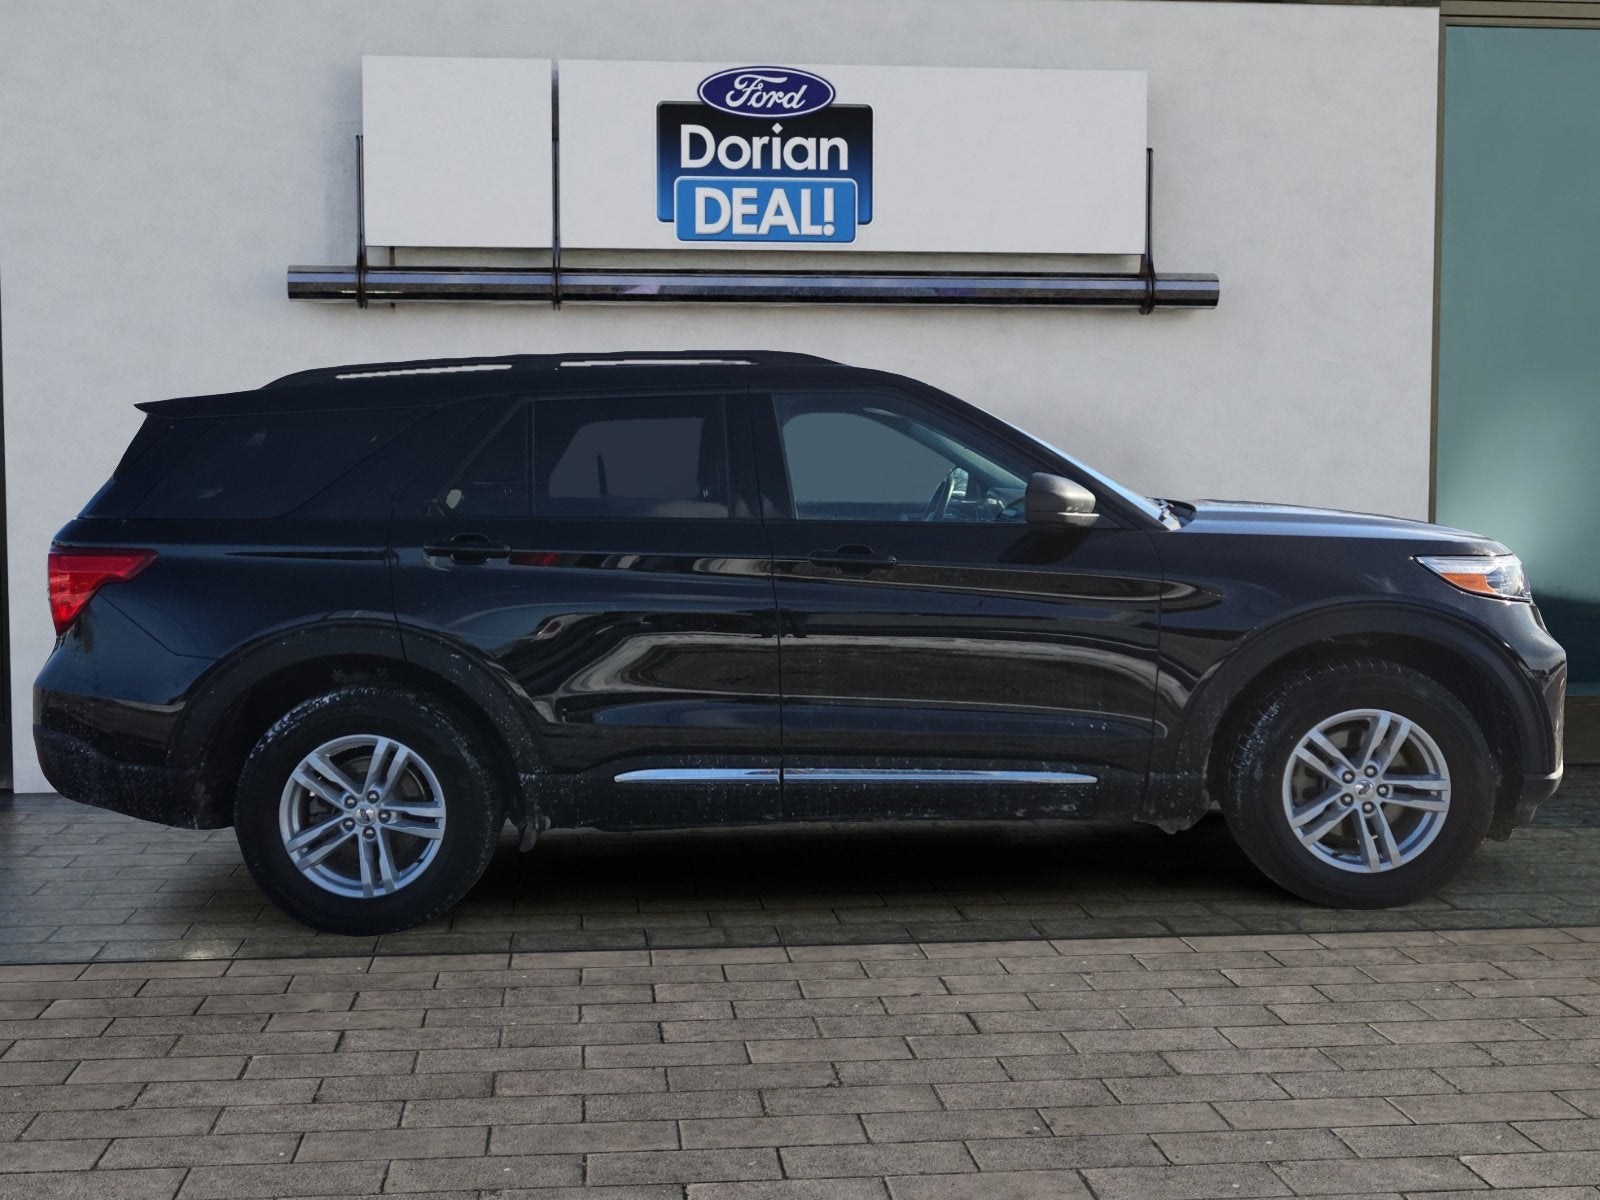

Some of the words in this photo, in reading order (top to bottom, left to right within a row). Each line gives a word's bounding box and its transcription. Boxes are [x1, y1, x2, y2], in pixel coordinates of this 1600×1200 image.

[725, 74, 808, 108] Ford
[680, 122, 849, 170] Dorian
[695, 187, 836, 237] DEAL!
